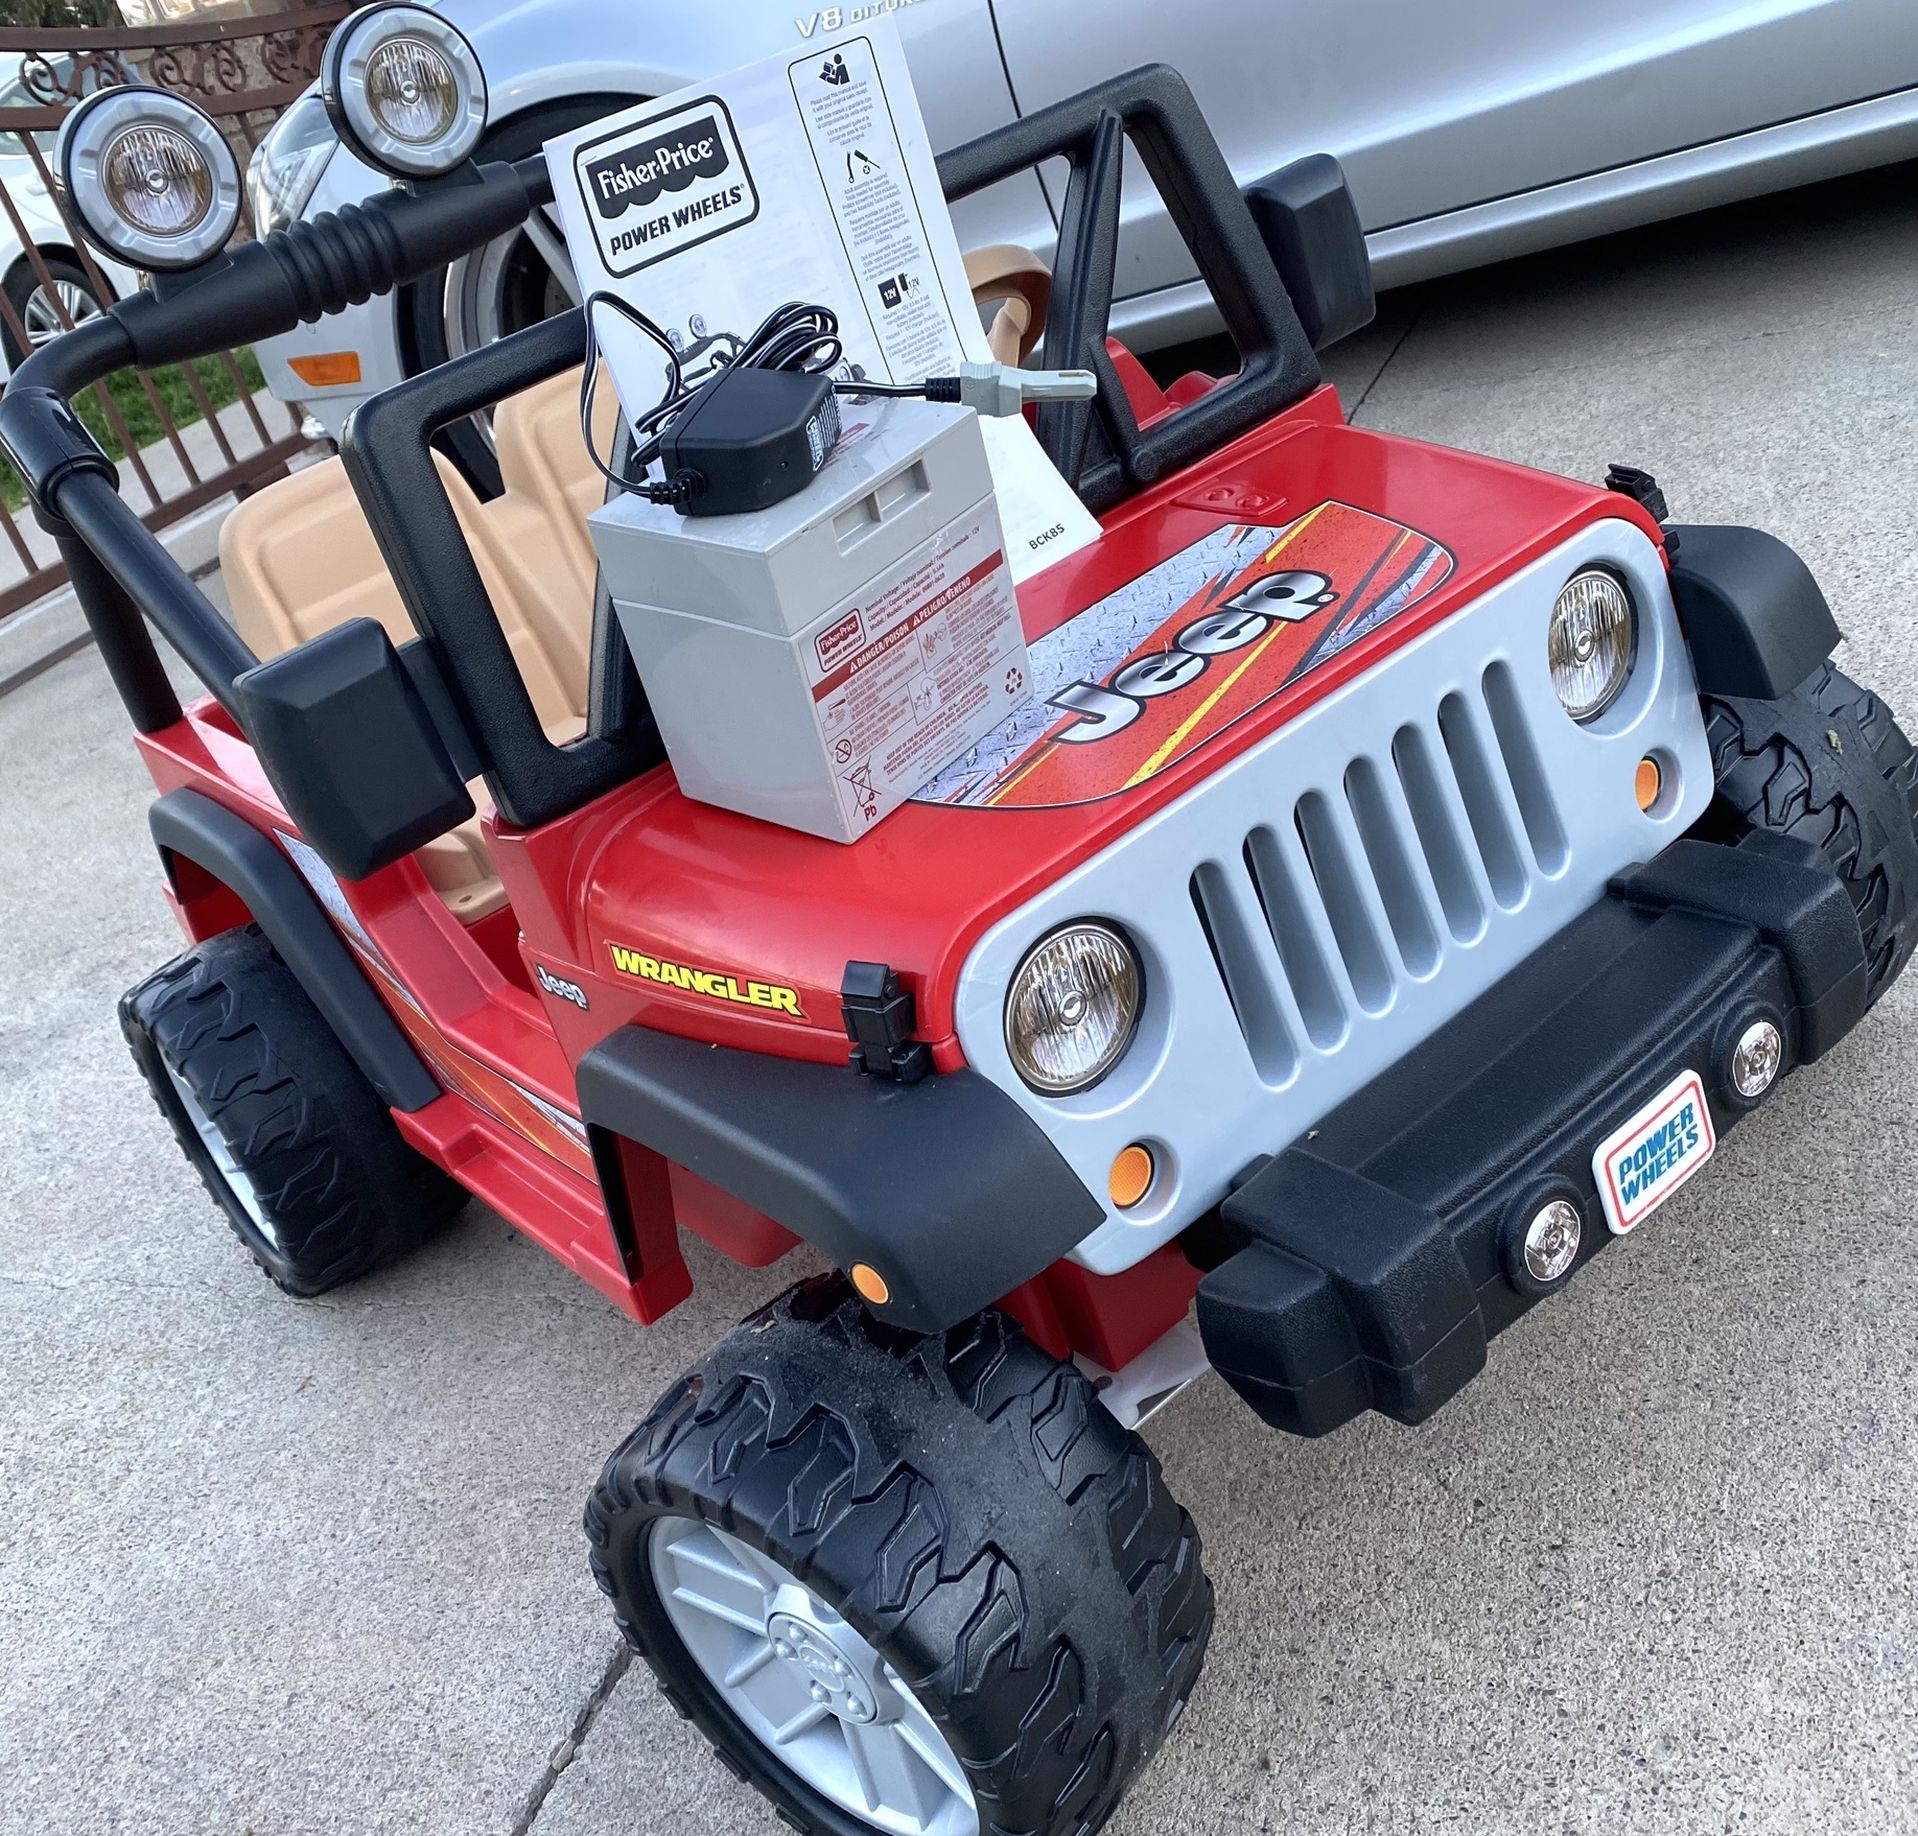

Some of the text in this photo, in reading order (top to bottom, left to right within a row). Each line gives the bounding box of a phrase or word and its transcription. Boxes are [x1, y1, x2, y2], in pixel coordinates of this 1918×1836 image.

[795, 7, 842, 38] V8
[610, 185, 742, 256] POWER WHEELS
[884, 287, 897, 300] 12V
[1029, 523, 1065, 550] BCK85
[820, 621, 857, 650] Fisher-Price
[857, 622, 909, 664] DANGER/POISON
[1045, 570, 1334, 743] Jeep
[824, 649, 842, 666] POWER
[864, 804, 877, 821] Pb
[537, 965, 590, 1011] Jeep
[610, 944, 807, 1018] WRANGLER
[1619, 1102, 1694, 1185] POWER
[1621, 1123, 1699, 1206] WHEELS
